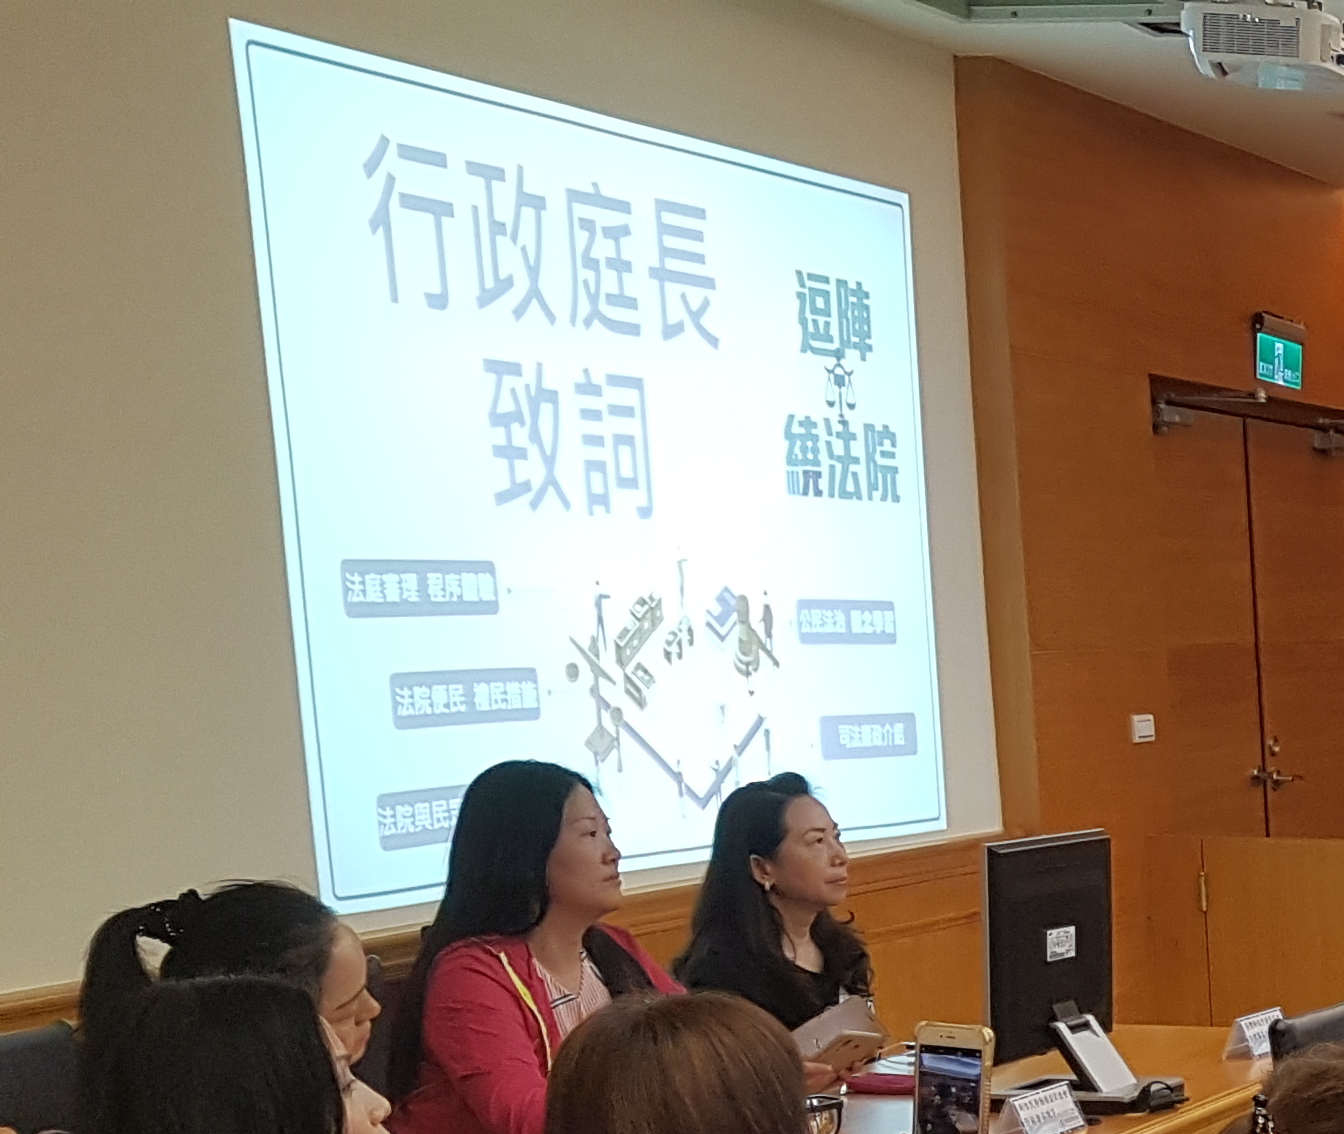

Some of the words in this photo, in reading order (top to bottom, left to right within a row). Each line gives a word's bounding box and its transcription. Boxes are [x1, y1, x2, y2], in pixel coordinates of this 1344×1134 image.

[362, 133, 720, 350] 行政庭長
[795, 269, 873, 362] 逗陣
[483, 358, 653, 520] 致詞
[784, 413, 901, 503] 繞法院
